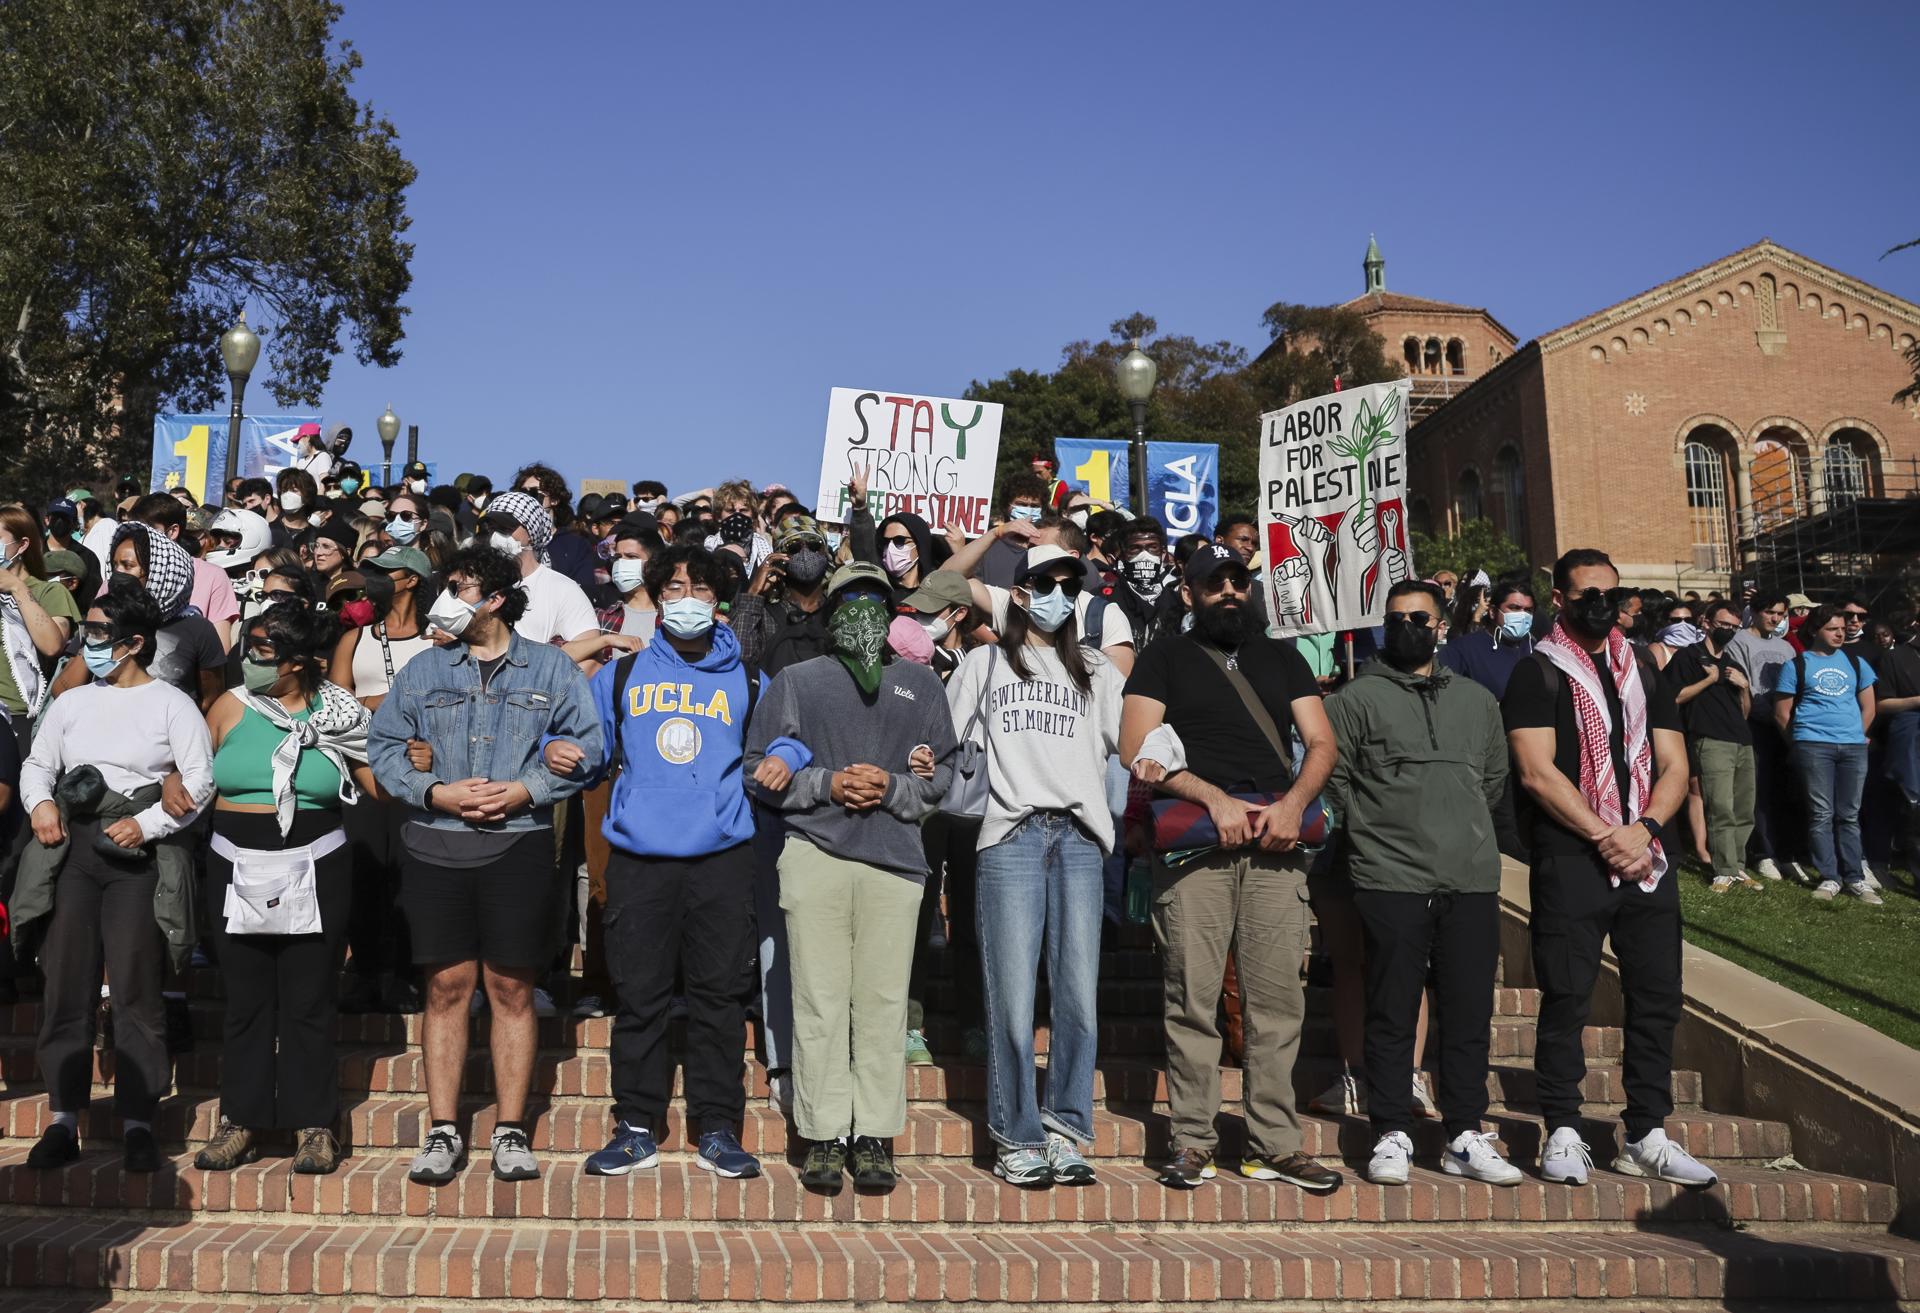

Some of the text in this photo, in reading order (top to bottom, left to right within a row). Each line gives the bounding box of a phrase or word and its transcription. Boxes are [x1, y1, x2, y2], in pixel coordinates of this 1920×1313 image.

[847, 392, 983, 460] STAY
[1269, 402, 1342, 447] LABOR
[840, 446, 958, 495] STRONG
[1287, 443, 1323, 473] FOR
[822, 487, 989, 535] #FEEPALESTINE
[1211, 545, 1230, 559] LA
[628, 682, 733, 727] UCLA
[991, 681, 1087, 717] SWITZERLAND
